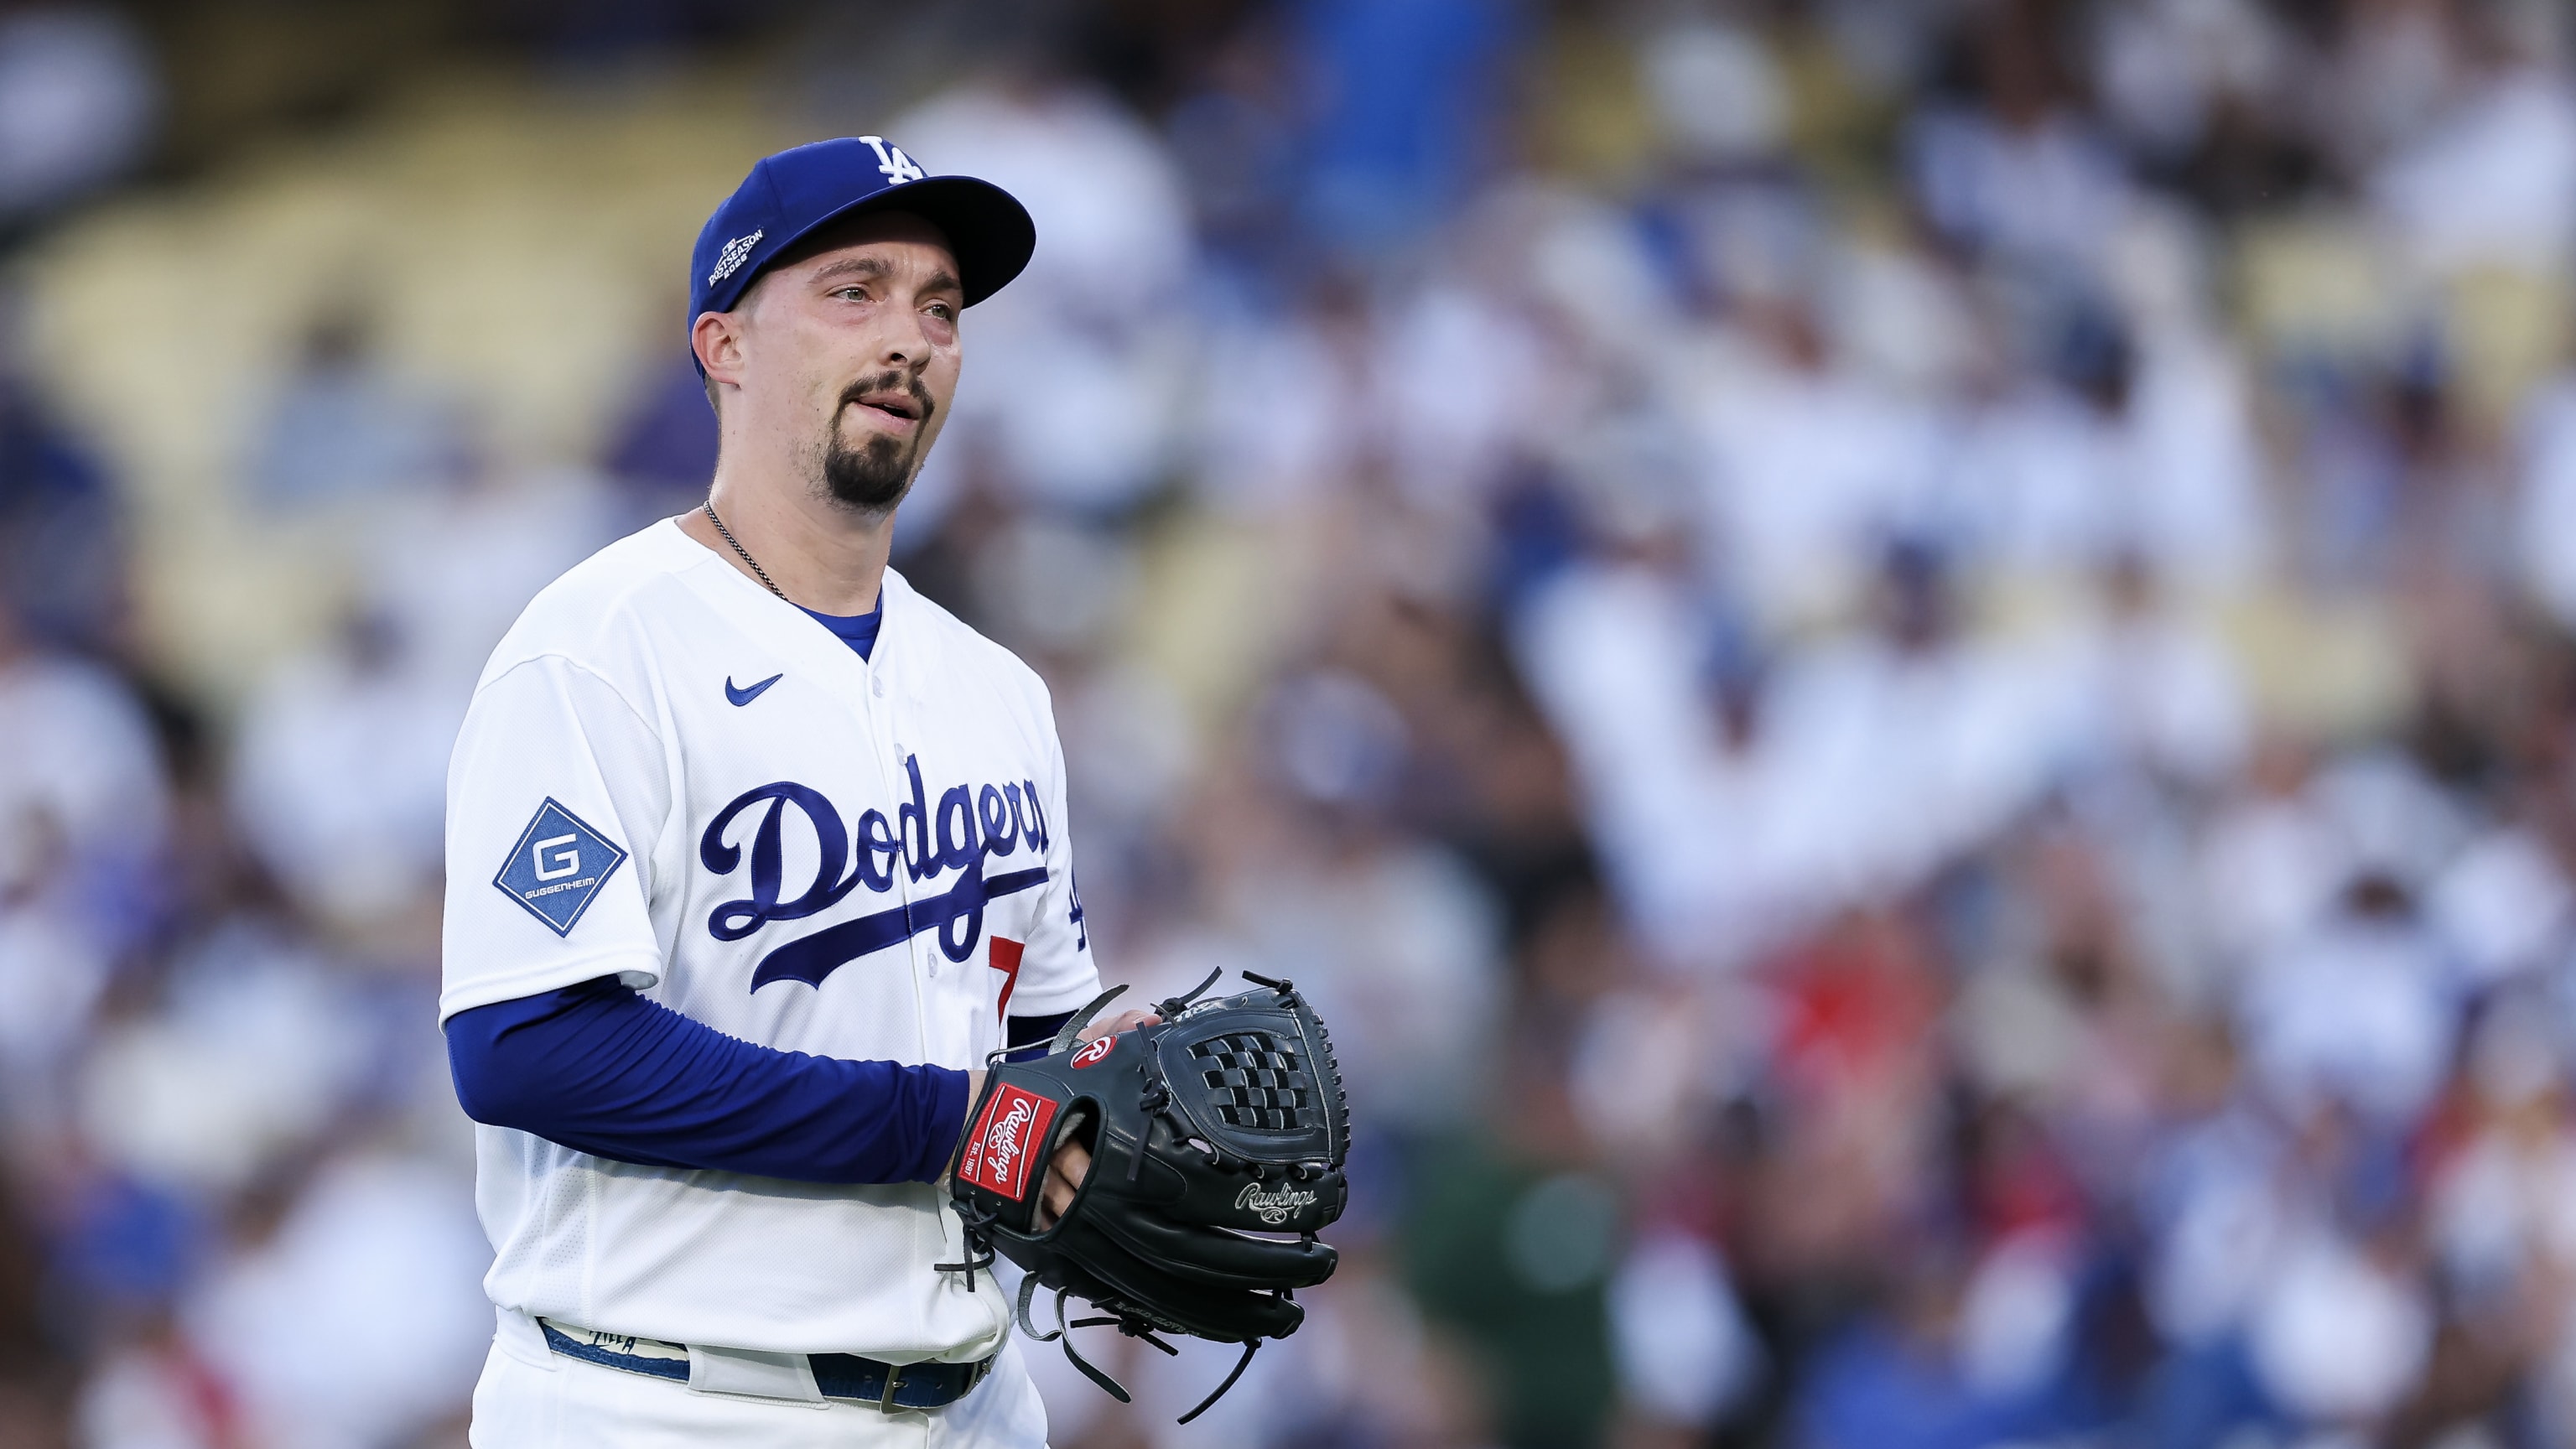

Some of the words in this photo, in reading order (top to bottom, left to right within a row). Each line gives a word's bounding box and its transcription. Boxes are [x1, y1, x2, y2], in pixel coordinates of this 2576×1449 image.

[858, 136, 923, 185] LA
[709, 229, 763, 288] POSTSEASON
[532, 833, 581, 882] G
[525, 877, 595, 900] GUGGENHEIM
[988, 1098, 1031, 1185] Rawlings
[964, 1157, 975, 1176] 1887
[1235, 1182, 1317, 1219] Rawlings
